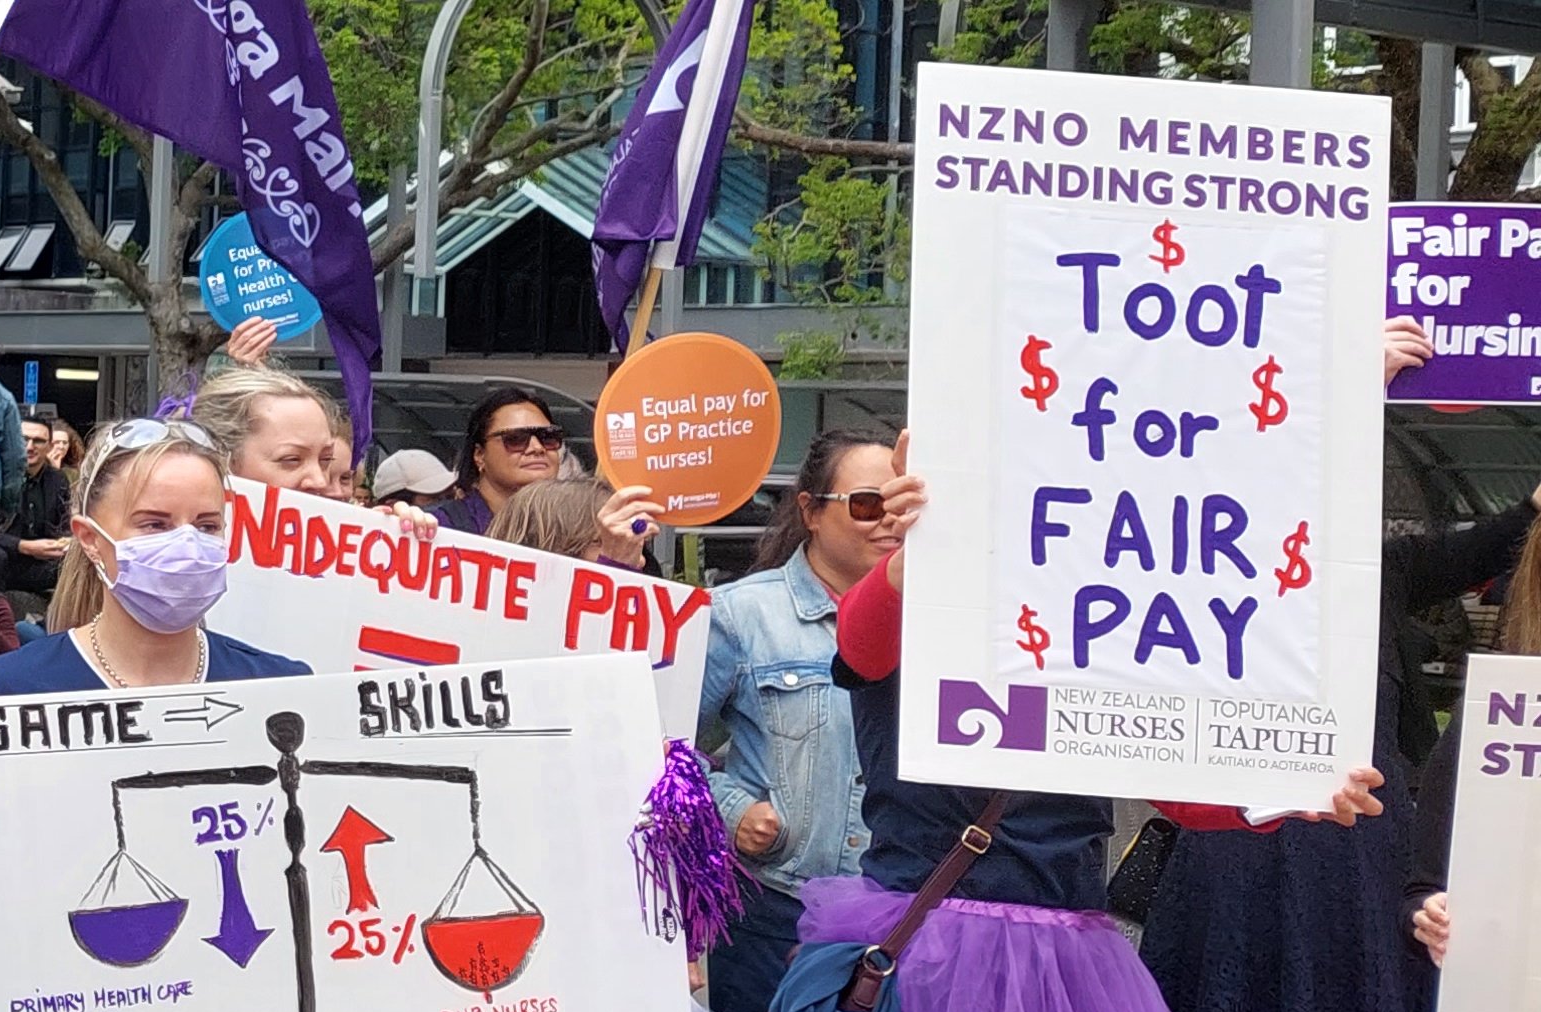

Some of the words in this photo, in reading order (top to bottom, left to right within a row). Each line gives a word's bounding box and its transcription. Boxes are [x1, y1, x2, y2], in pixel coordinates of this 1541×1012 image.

[939, 104, 1089, 147] NZNO
[1119, 116, 1371, 169] MEMBERS
[935, 155, 1174, 205] STANDING
[1183, 174, 1370, 221] STRONG
[228, 245, 262, 262] Equa
[1148, 217, 1185, 274] $
[1391, 213, 1491, 257] Fair
[233, 263, 254, 279] for
[238, 273, 285, 297] Health
[1391, 262, 1471, 306] for
[243, 289, 294, 314] nurses!
[1056, 252, 1282, 348] Toot
[1021, 335, 1059, 412] $
[1249, 355, 1288, 432] $
[642, 393, 697, 420] Equal
[703, 394, 736, 416] pay
[742, 388, 770, 408] for
[1070, 377, 1219, 461] for
[644, 423, 671, 443] GP
[678, 417, 754, 441] Practice
[646, 446, 713, 471] nurses!
[1031, 486, 1257, 579] FAIR
[1275, 520, 1312, 597] $
[565, 567, 712, 670] PAY
[1016, 604, 1050, 671] $
[1073, 584, 1259, 680] PAY
[1054, 688, 1097, 706] NEW
[1101, 691, 1186, 712] ZEALAND
[1054, 710, 1185, 742] NURSES
[1208, 724, 1337, 756] TAPUHI
[1053, 740, 1184, 763] ORGANISATION
[1208, 755, 1255, 768] KAITIAKI
[1258, 759, 1268, 769] O
[1270, 760, 1335, 774] AOTEAROA
[93, 985, 154, 1009] HEALTH
[158, 980, 194, 1004] CARE
